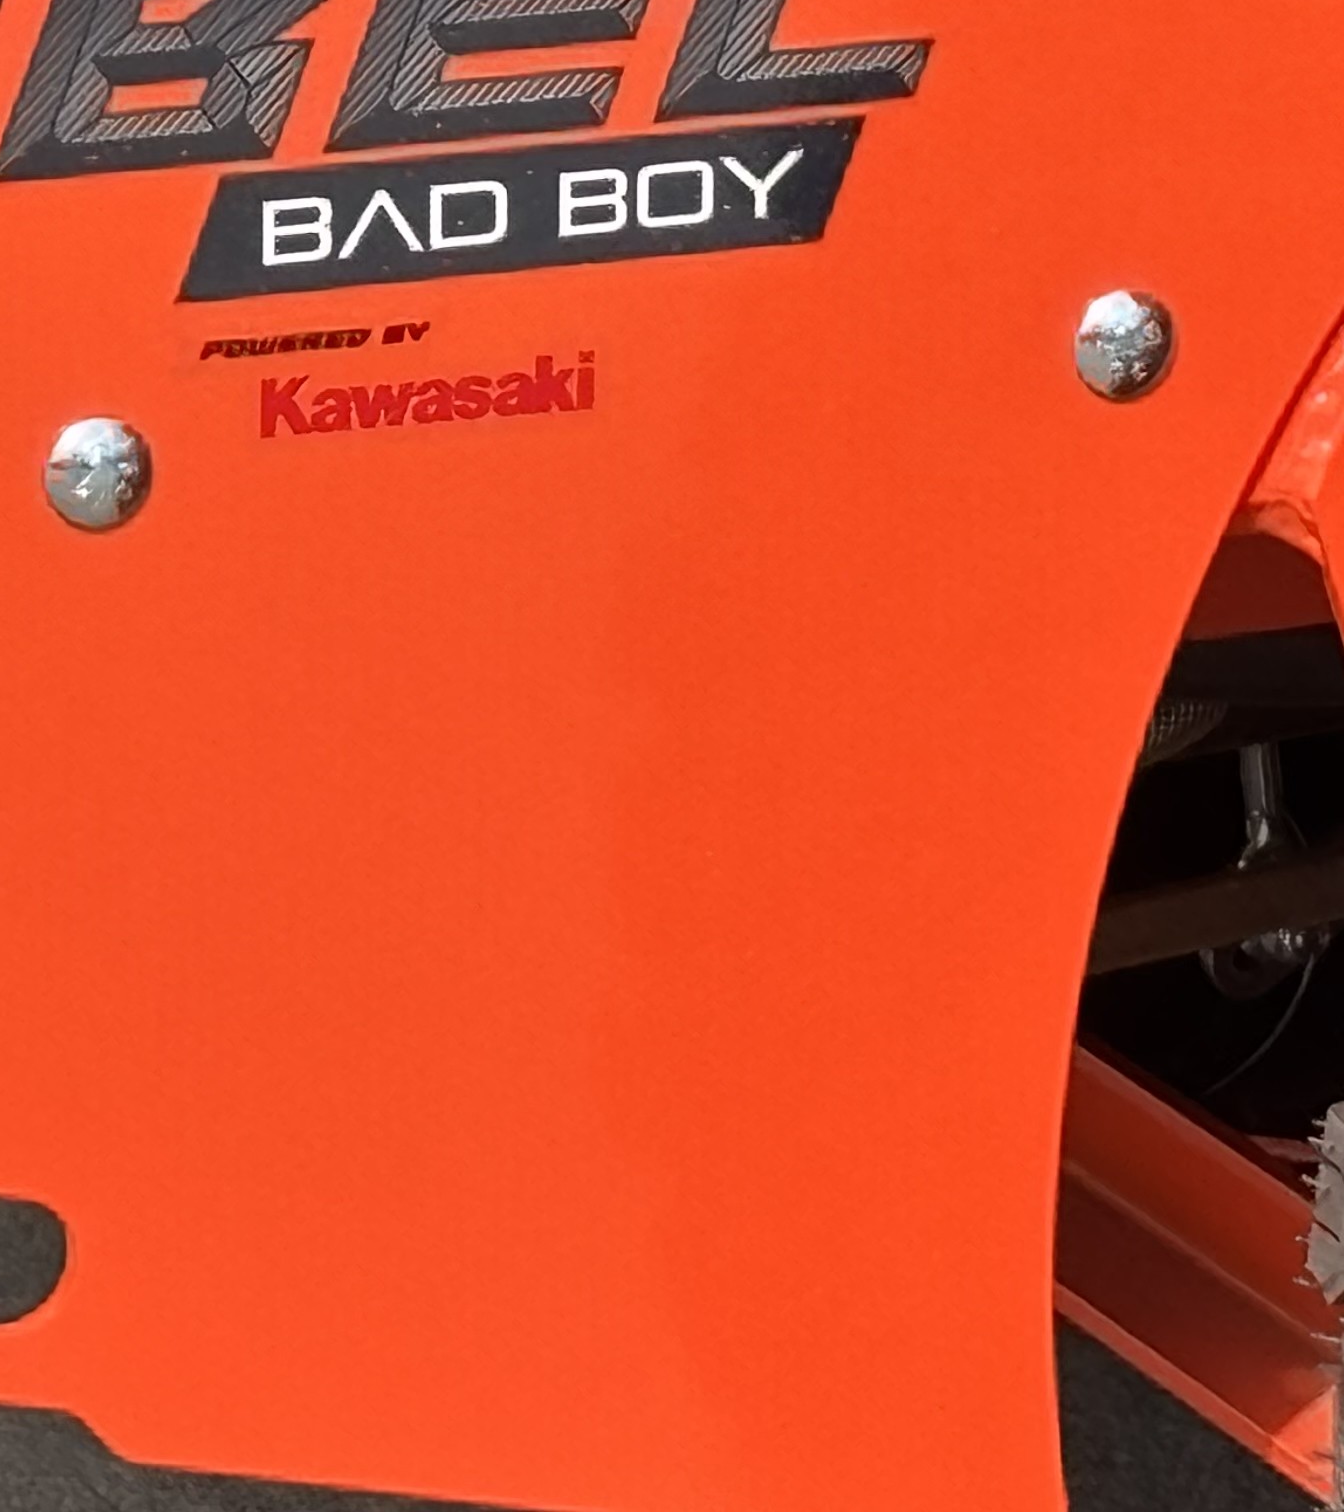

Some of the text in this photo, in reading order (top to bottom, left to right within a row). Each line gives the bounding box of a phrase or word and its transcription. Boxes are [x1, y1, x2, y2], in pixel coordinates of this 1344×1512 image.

[262, 146, 805, 267] BAD BOY
[199, 321, 431, 361] POWERED BY
[260, 351, 596, 439] Kawasaki
